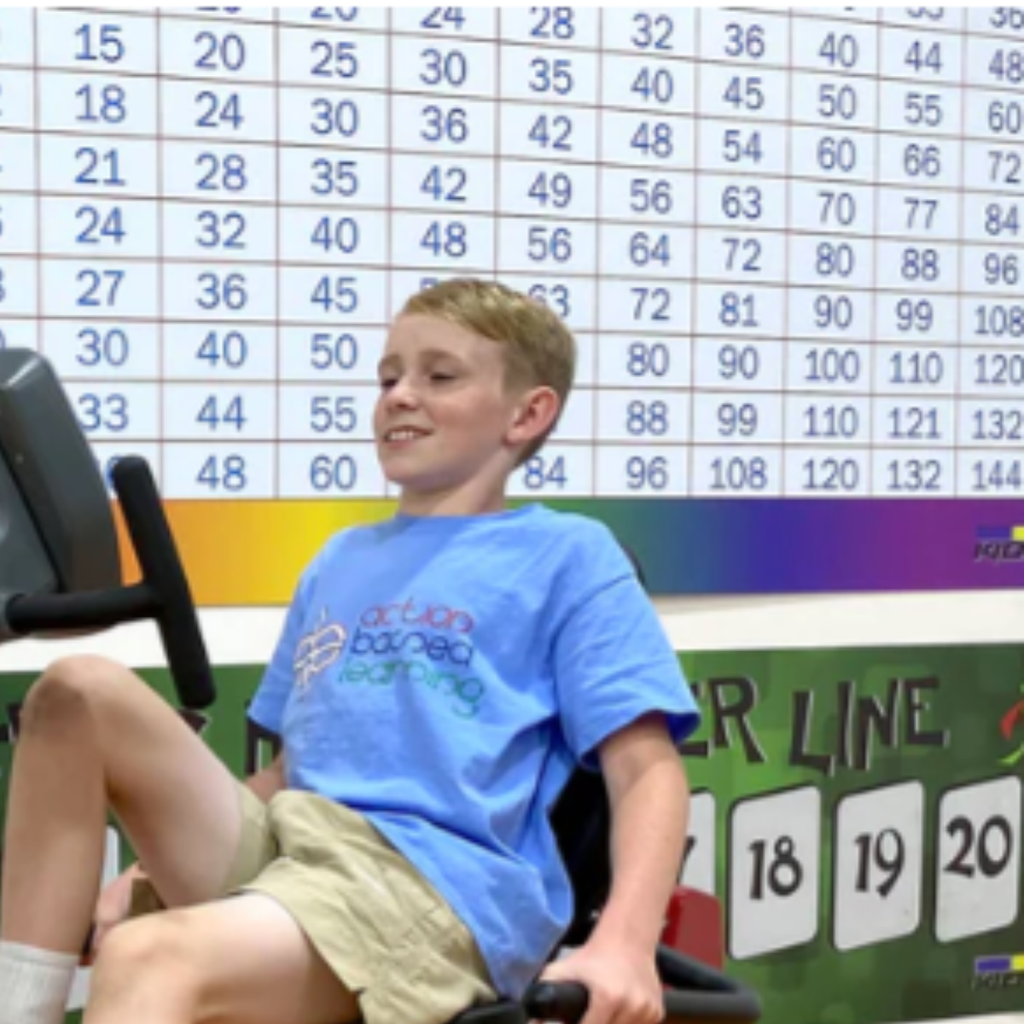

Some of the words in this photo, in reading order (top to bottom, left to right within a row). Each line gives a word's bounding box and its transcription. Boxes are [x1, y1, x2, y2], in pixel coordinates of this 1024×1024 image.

[75, 24, 125, 64] 15
[194, 31, 245, 71] 20
[310, 40, 358, 78] 25
[420, 48, 467, 87] 30
[529, 57, 573, 95] 35
[630, 67, 673, 104] 40
[723, 77, 764, 110] 45
[818, 84, 856, 120] 50
[905, 92, 942, 127] 55
[988, 101, 1024, 134] 60
[530, 8, 575, 40] 28
[631, 13, 673, 50] 32
[725, 23, 765, 59] 36
[819, 32, 858, 68] 40
[904, 41, 942, 73] 44
[989, 50, 1024, 84] 48
[75, 84, 126, 123] 18
[195, 91, 244, 130] 24
[311, 98, 359, 137] 30
[421, 105, 468, 143] 36
[528, 115, 572, 151] 42
[630, 122, 673, 158] 48
[724, 129, 762, 162] 54
[817, 136, 856, 172] 60
[904, 143, 940, 177] 66
[989, 151, 1021, 184] 72
[75, 147, 125, 186] 21
[196, 152, 247, 192] 28
[311, 158, 358, 197] 35
[420, 165, 467, 202] 42
[528, 172, 572, 208] 49
[630, 179, 672, 214] 56
[722, 185, 762, 220] 63
[818, 191, 856, 226] 70
[905, 197, 938, 229] 77
[985, 203, 1020, 236] 84
[75, 206, 126, 244] 24
[196, 210, 245, 249] 32
[311, 216, 359, 254] 40
[420, 221, 467, 258] 48
[528, 226, 572, 263] 56
[629, 232, 670, 267] 64
[723, 238, 761, 272] 72
[816, 242, 854, 277] 80
[901, 248, 939, 281] 88
[984, 253, 1018, 285] 96
[77, 269, 125, 306] 27
[196, 272, 247, 310] 36
[310, 276, 358, 313] 45
[631, 287, 670, 321] 72
[719, 292, 758, 327] 81
[814, 295, 852, 330] 90
[896, 298, 933, 332] 99
[975, 305, 1024, 337] 108
[76, 328, 129, 366] 30
[196, 331, 247, 368] 40
[311, 333, 358, 370] 50
[627, 342, 669, 377] 80
[718, 344, 759, 380] 90
[805, 348, 860, 383] 100
[890, 352, 943, 384] 110
[975, 354, 1024, 385] 120
[79, 393, 130, 432] 33
[196, 395, 246, 431] 44
[311, 396, 357, 432] 55
[626, 400, 668, 435] 88
[718, 403, 757, 436] 99
[804, 406, 858, 438] 110
[890, 407, 940, 439] 121
[973, 409, 1024, 440] 132
[196, 454, 246, 491] 48
[310, 454, 357, 491] 60
[523, 455, 569, 489] 84
[626, 456, 668, 490] 96
[710, 456, 767, 490] 108
[803, 458, 859, 491] 120
[888, 459, 941, 491] 132
[973, 460, 1021, 491] 144
[788, 676, 949, 776] LINE
[748, 835, 804, 901] 18
[853, 828, 906, 899] 19
[943, 815, 1014, 880] 20
